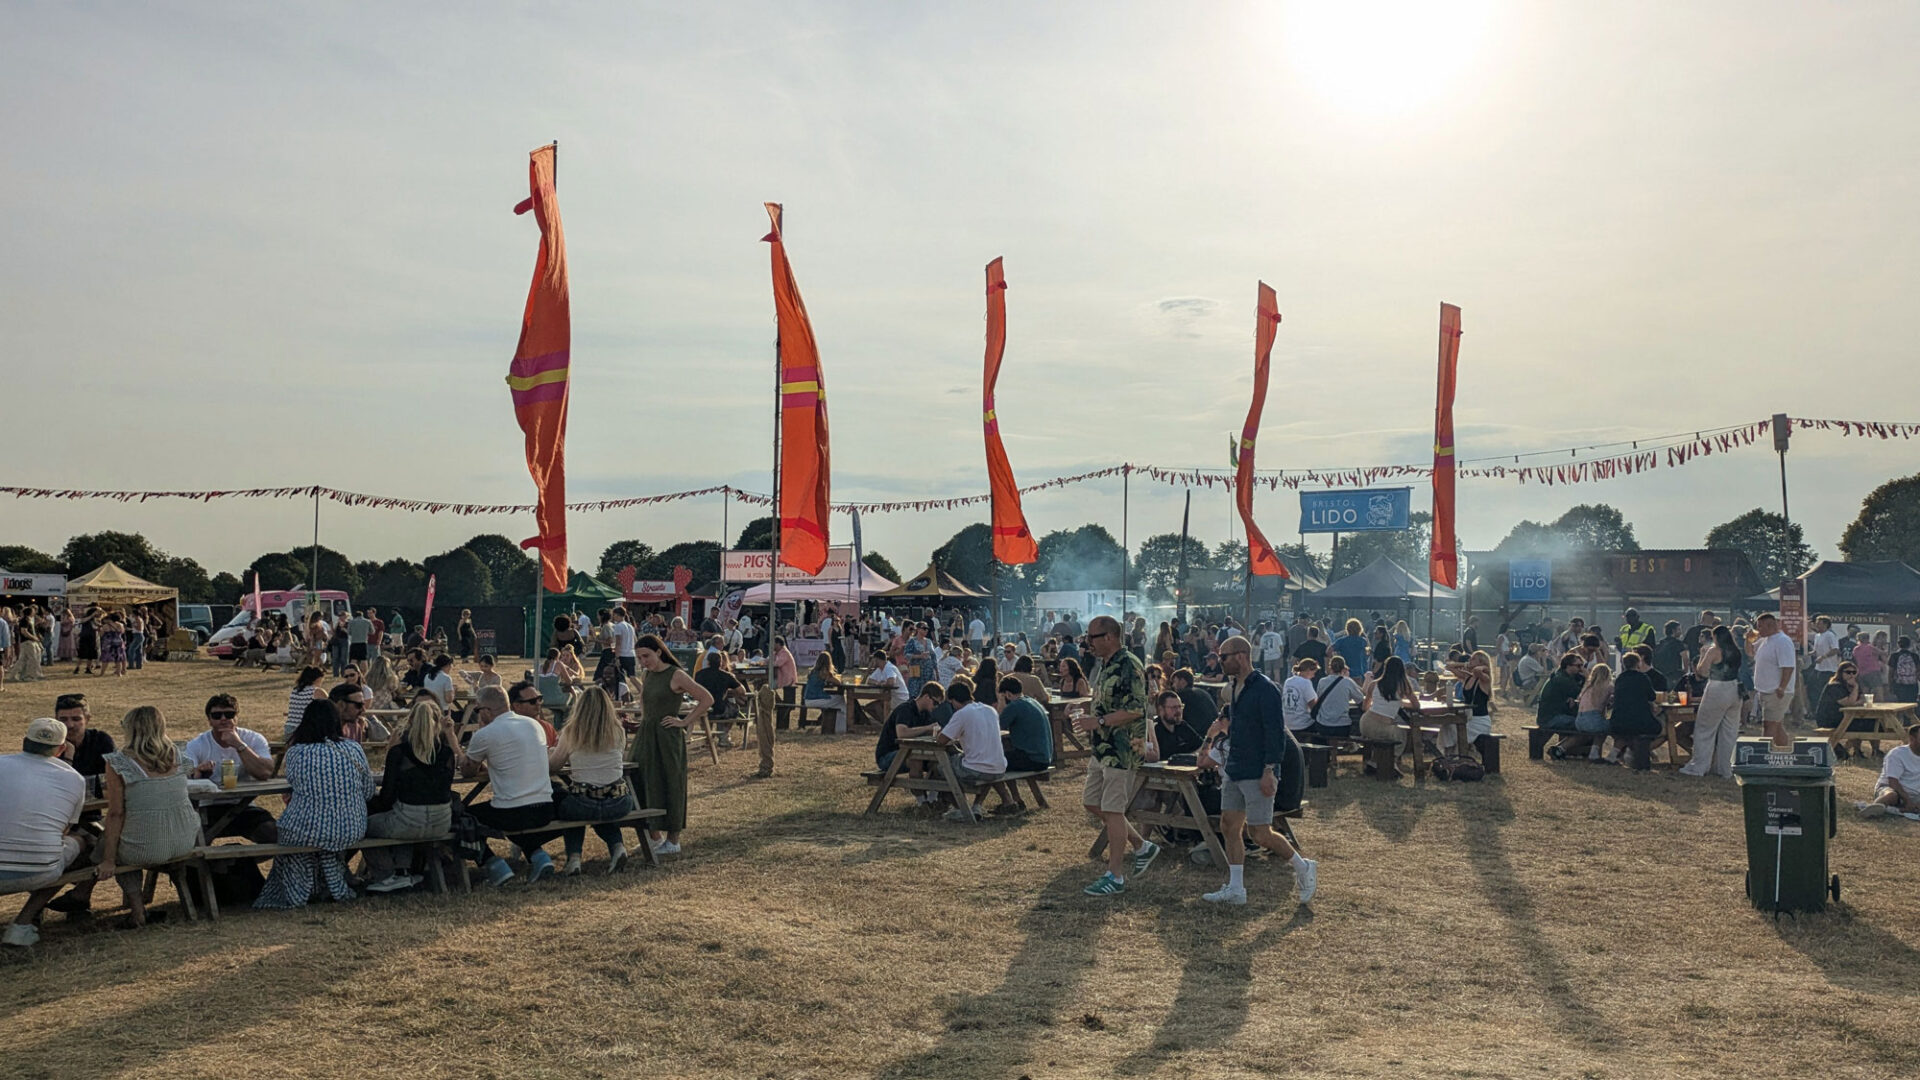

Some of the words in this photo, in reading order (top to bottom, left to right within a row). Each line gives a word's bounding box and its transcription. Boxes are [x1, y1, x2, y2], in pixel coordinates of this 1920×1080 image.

[1312, 500, 1356, 508] BRISTOL
[1312, 509, 1357, 524] LIDO
[743, 554, 774, 568] PIG'S
[1513, 578, 1547, 588] LIDO
